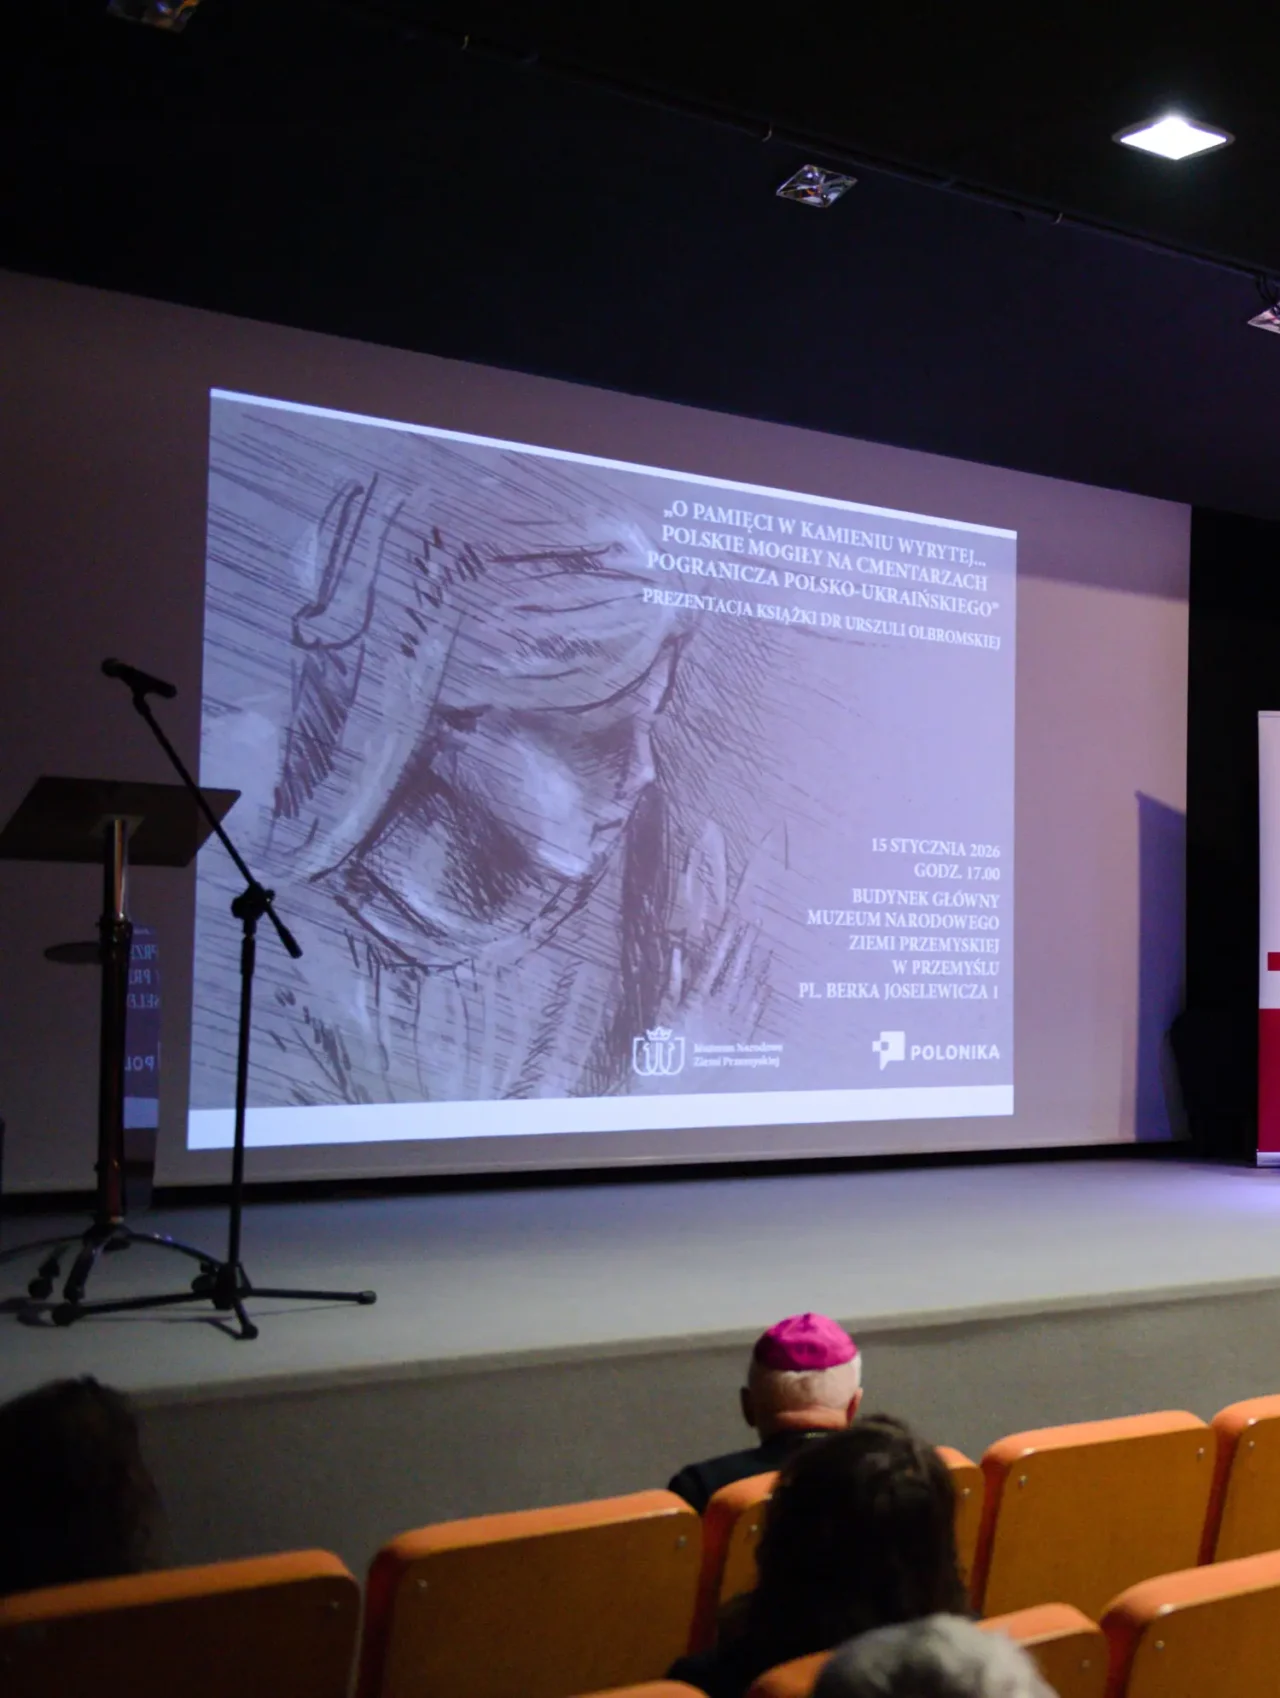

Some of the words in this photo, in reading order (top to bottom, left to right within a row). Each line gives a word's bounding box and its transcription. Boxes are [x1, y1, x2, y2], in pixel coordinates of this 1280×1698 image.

[693, 504, 773, 533] PAMIĘCI
[779, 517, 797, 534] W
[801, 521, 893, 551] KAMIENIU
[898, 537, 986, 567] WYRYTEJ...
[647, 550, 779, 587] POGRANICZA
[662, 525, 744, 553] POLSKIE
[748, 541, 824, 565] MOGIŁY
[827, 553, 853, 571] NA
[856, 556, 987, 592] CMENTARZACH
[643, 589, 752, 617] PREZENTACJA
[756, 605, 817, 626] KSIĄŻKI
[821, 613, 842, 629] DR
[845, 616, 906, 638] URSZULI
[909, 625, 1001, 651] OLBROMSKIEJ
[872, 838, 887, 852] 15
[890, 838, 966, 856] STYCZNIA
[970, 844, 1000, 858] 2026
[914, 862, 962, 879] GODZ.
[967, 867, 1000, 880] 17.00
[852, 888, 929, 906] BUDYNEK
[932, 890, 1000, 908] GŁÓWNY
[807, 909, 881, 927] MUZEUM
[885, 912, 1000, 930] NARODOWEGO
[849, 935, 895, 950] ZIEMI
[899, 936, 1000, 954] PRZEMYSKIEJ
[892, 959, 907, 974] W
[912, 957, 1000, 976] PRZEMYŚLU
[799, 982, 821, 998] PL.
[826, 982, 880, 998] BERKA
[884, 983, 988, 1000] JOSELEWICZA
[993, 985, 998, 999] 1
[911, 1044, 1000, 1061] POLONIKA
